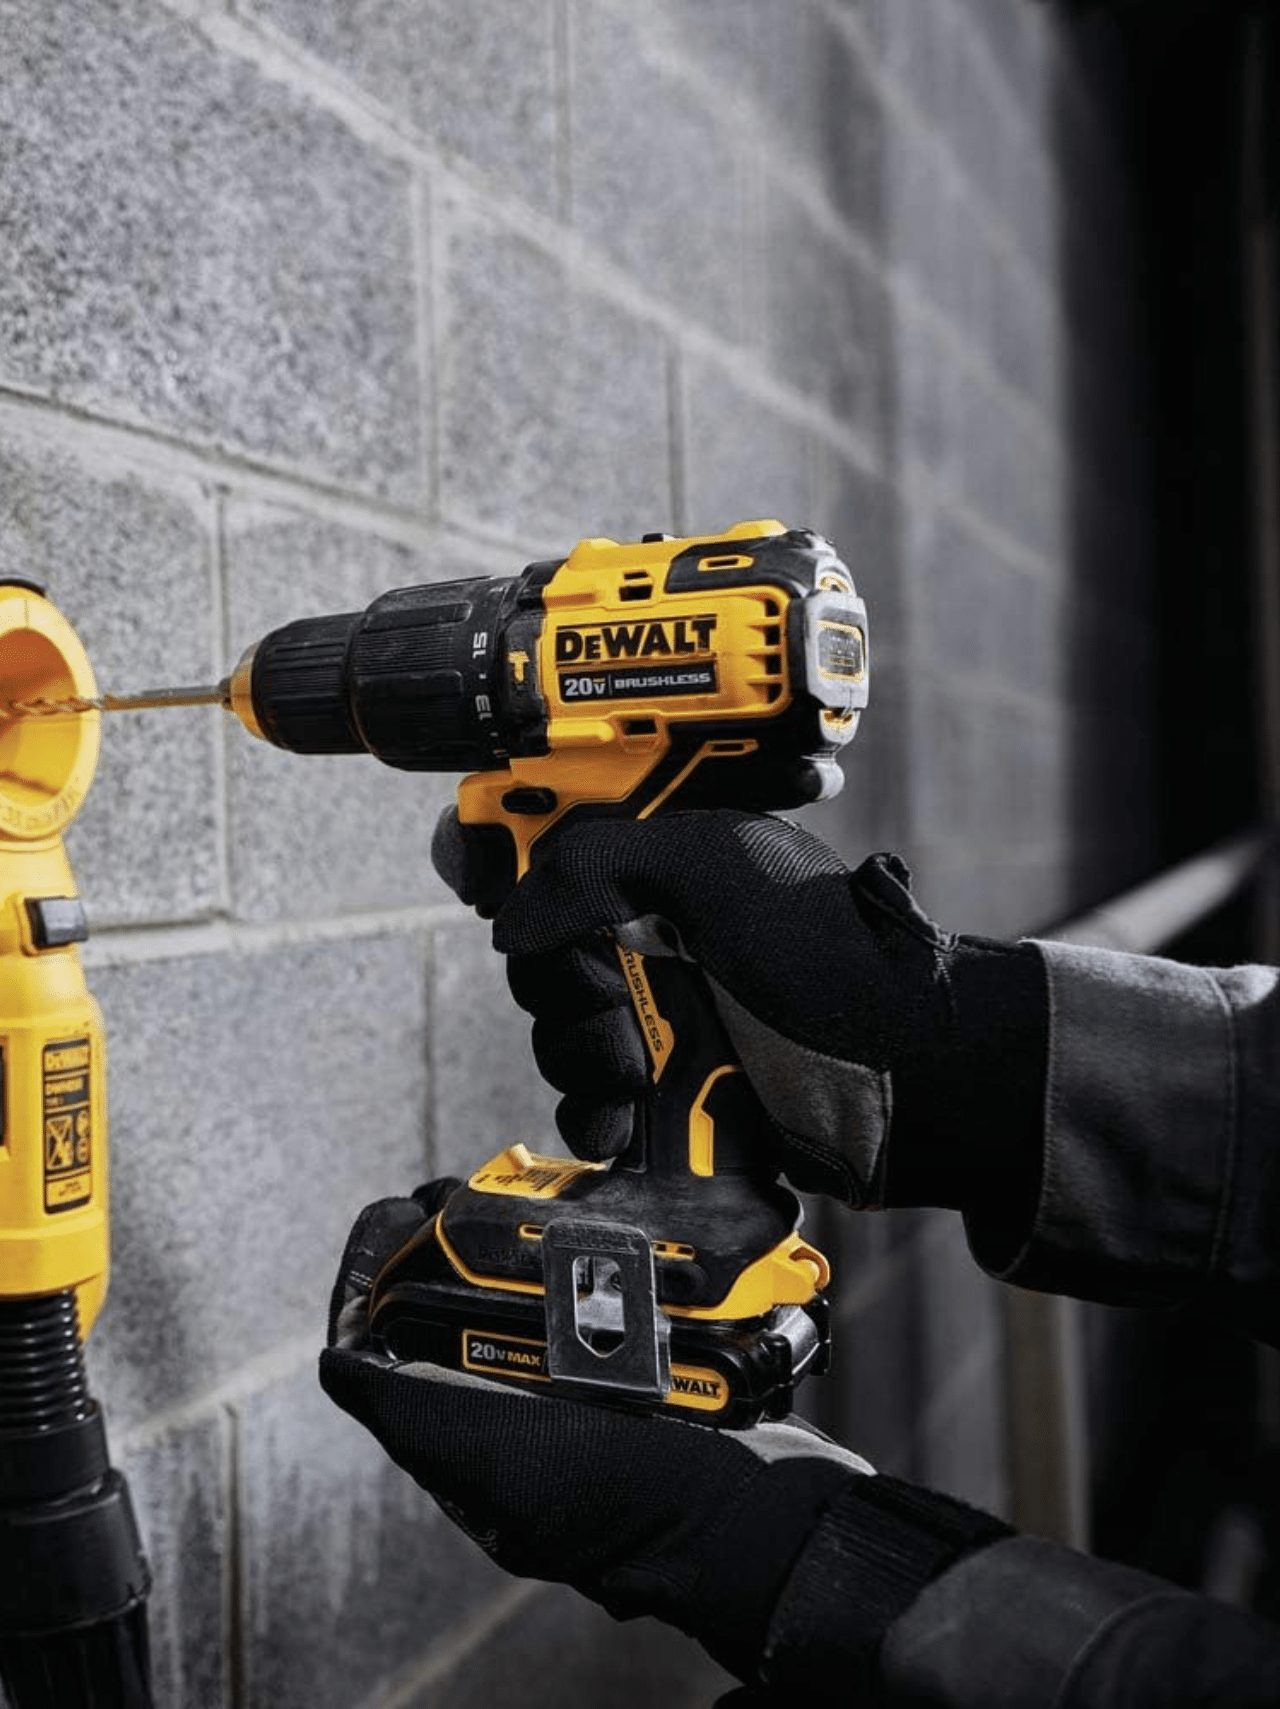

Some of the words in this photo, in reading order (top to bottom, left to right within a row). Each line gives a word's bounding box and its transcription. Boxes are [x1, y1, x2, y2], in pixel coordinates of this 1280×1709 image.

[472, 631, 488, 659] 15
[556, 619, 717, 662] DEWALT
[614, 672, 712, 689] BRUSHLESS
[474, 694, 493, 720] 13
[623, 951, 664, 1052] RUSHLESS
